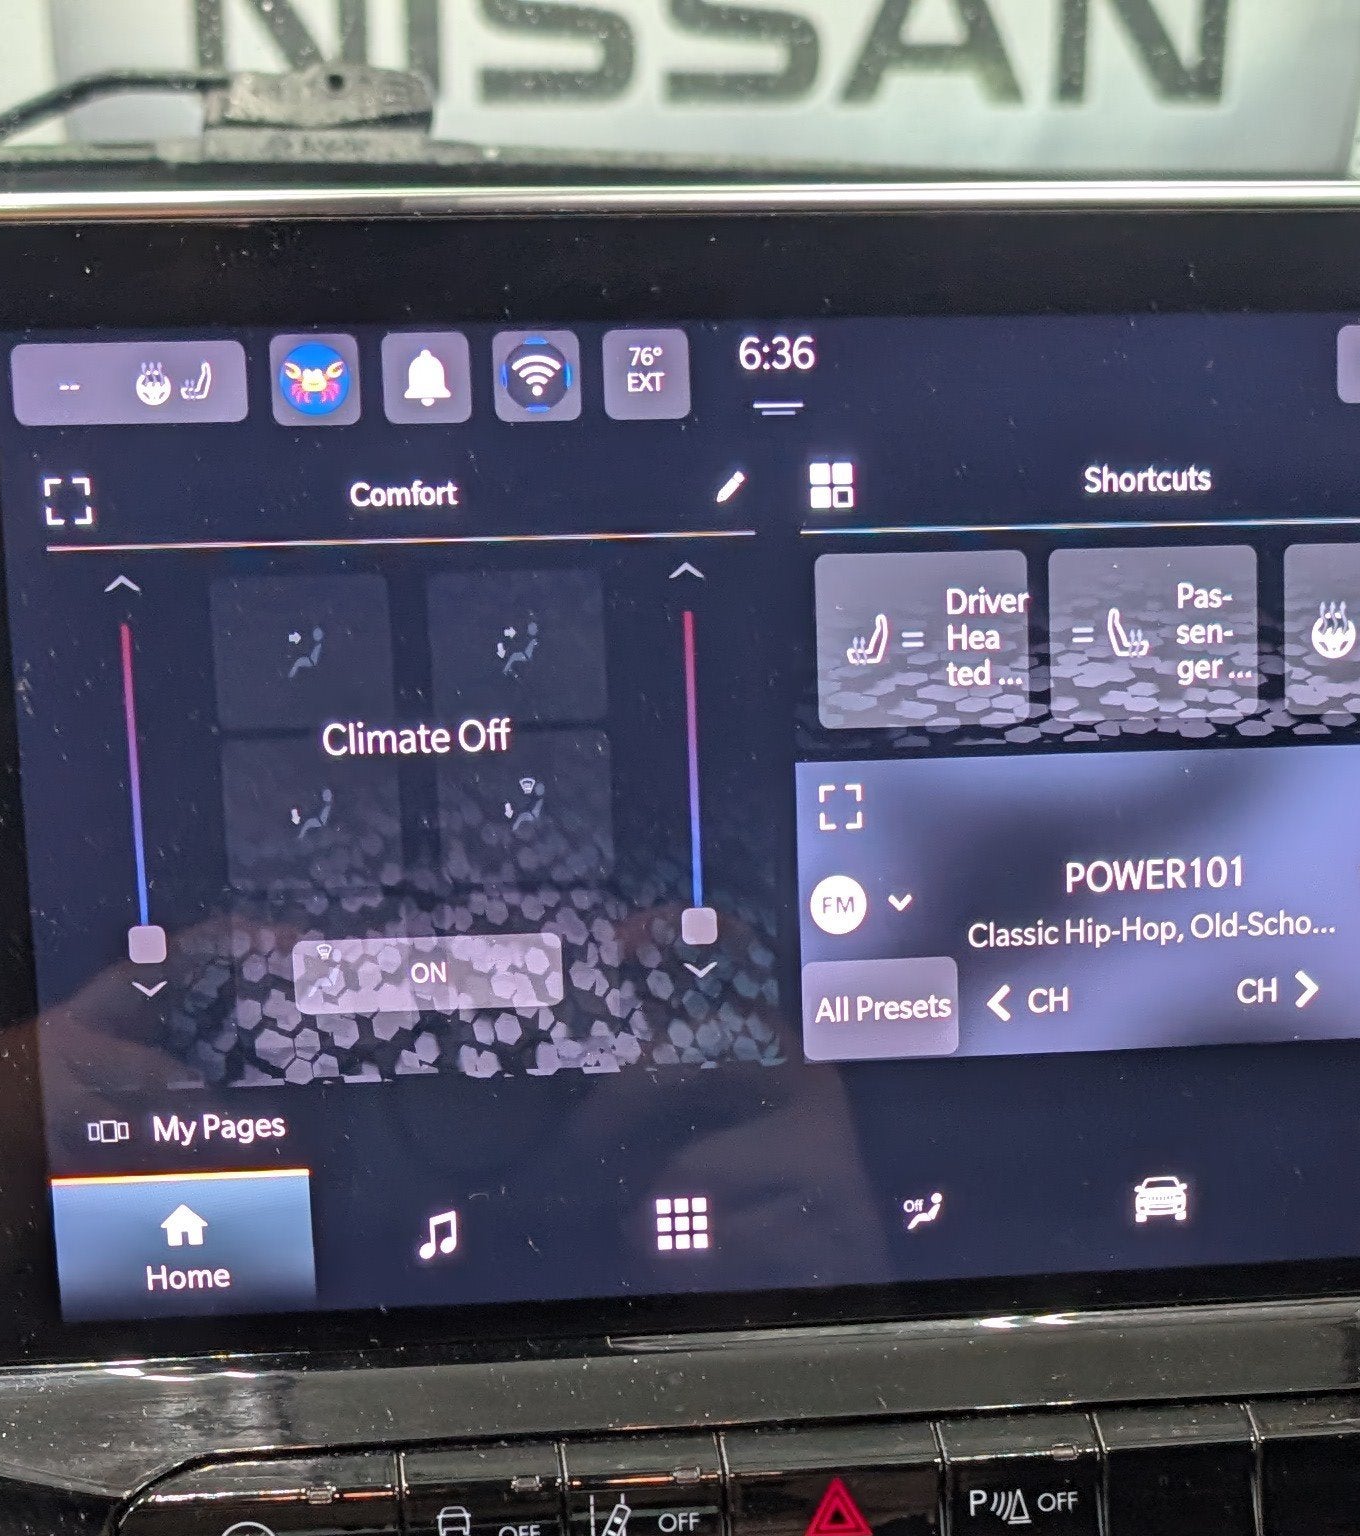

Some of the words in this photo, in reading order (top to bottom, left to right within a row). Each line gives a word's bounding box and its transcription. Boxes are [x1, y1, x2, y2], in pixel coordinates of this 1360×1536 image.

[629, 346, 663, 366] 76°
[739, 335, 815, 370] 6:36
[628, 371, 664, 392] EXT
[1085, 464, 1211, 493] Shortcuts
[350, 480, 458, 507] Comfort
[947, 587, 1029, 614] Driver
[1178, 582, 1232, 608] Pas-
[948, 624, 1000, 650] Hea
[1177, 623, 1233, 644] sen-
[946, 659, 990, 686] ted
[1177, 659, 1223, 685] ger
[323, 722, 450, 756] Climate
[459, 718, 511, 752] Off
[1066, 855, 1245, 894] POWER101
[820, 895, 857, 916] FM
[969, 920, 1058, 947] Classic
[1066, 917, 1184, 948] Hip-Hop,
[1190, 908, 1337, 939] Old-Scho...
[409, 962, 448, 985] ON
[1028, 987, 1068, 1013] CH
[1237, 977, 1277, 1003] CH
[815, 996, 848, 1023] All
[857, 994, 952, 1022] Presets
[153, 1115, 197, 1146] My
[203, 1114, 285, 1143] Pages
[147, 1265, 230, 1290] Home
[1038, 1492, 1077, 1511] OFF
[658, 1512, 699, 1532] OFF
